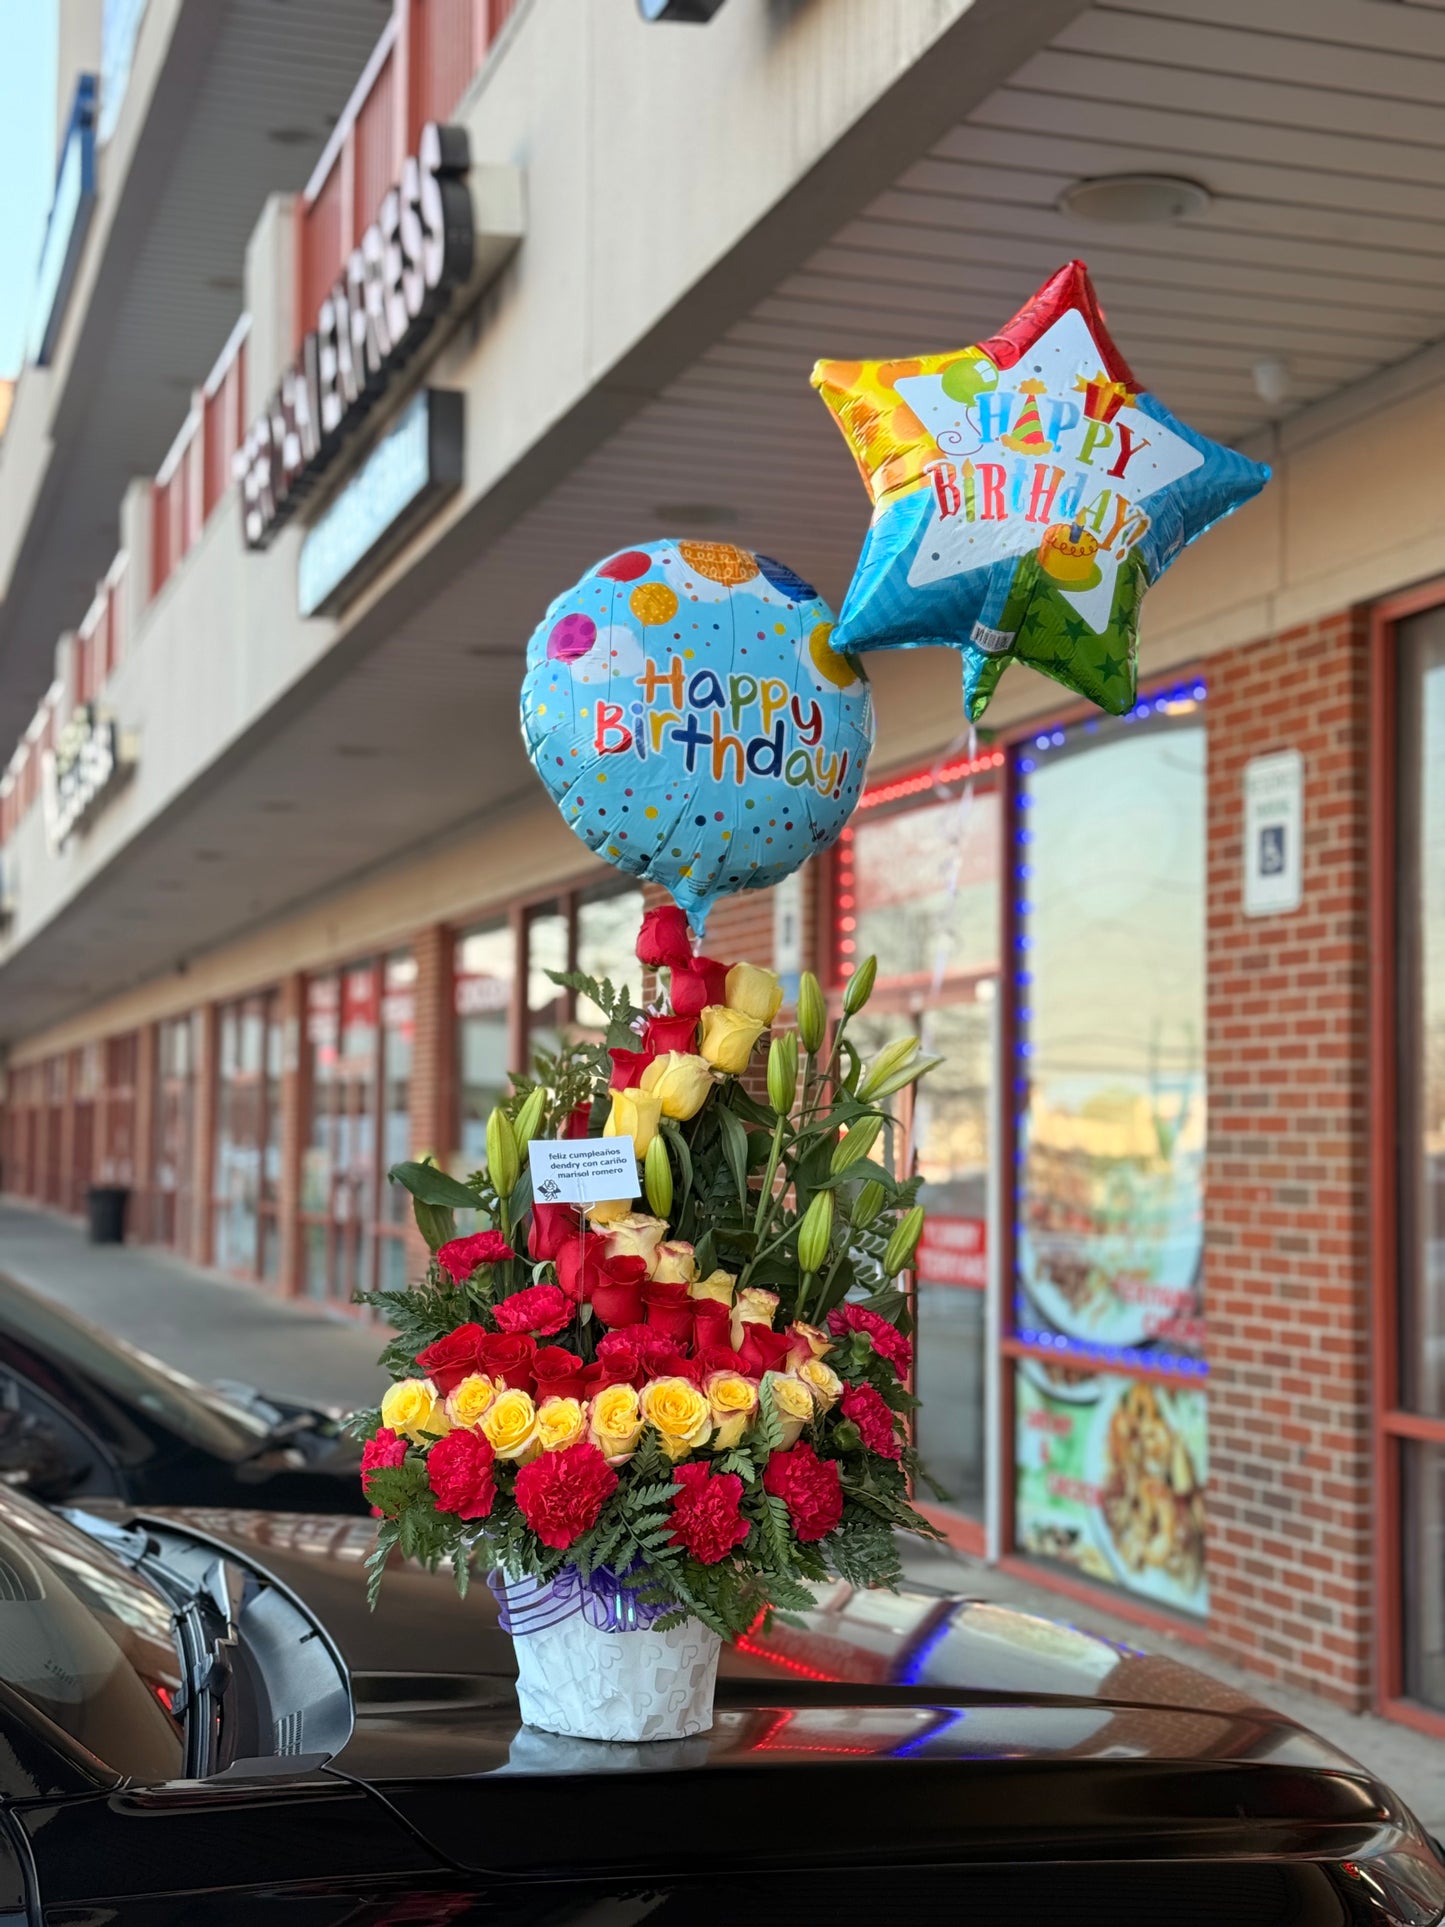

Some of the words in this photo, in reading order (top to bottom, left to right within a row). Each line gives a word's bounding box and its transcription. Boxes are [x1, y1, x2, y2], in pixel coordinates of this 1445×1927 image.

[975, 377, 1152, 480] HAPPY
[636, 655, 823, 746] Happy
[594, 700, 848, 800] Birthday!
[558, 1170, 589, 1178] marisol
[569, 1149, 620, 1159] cumpleaños
